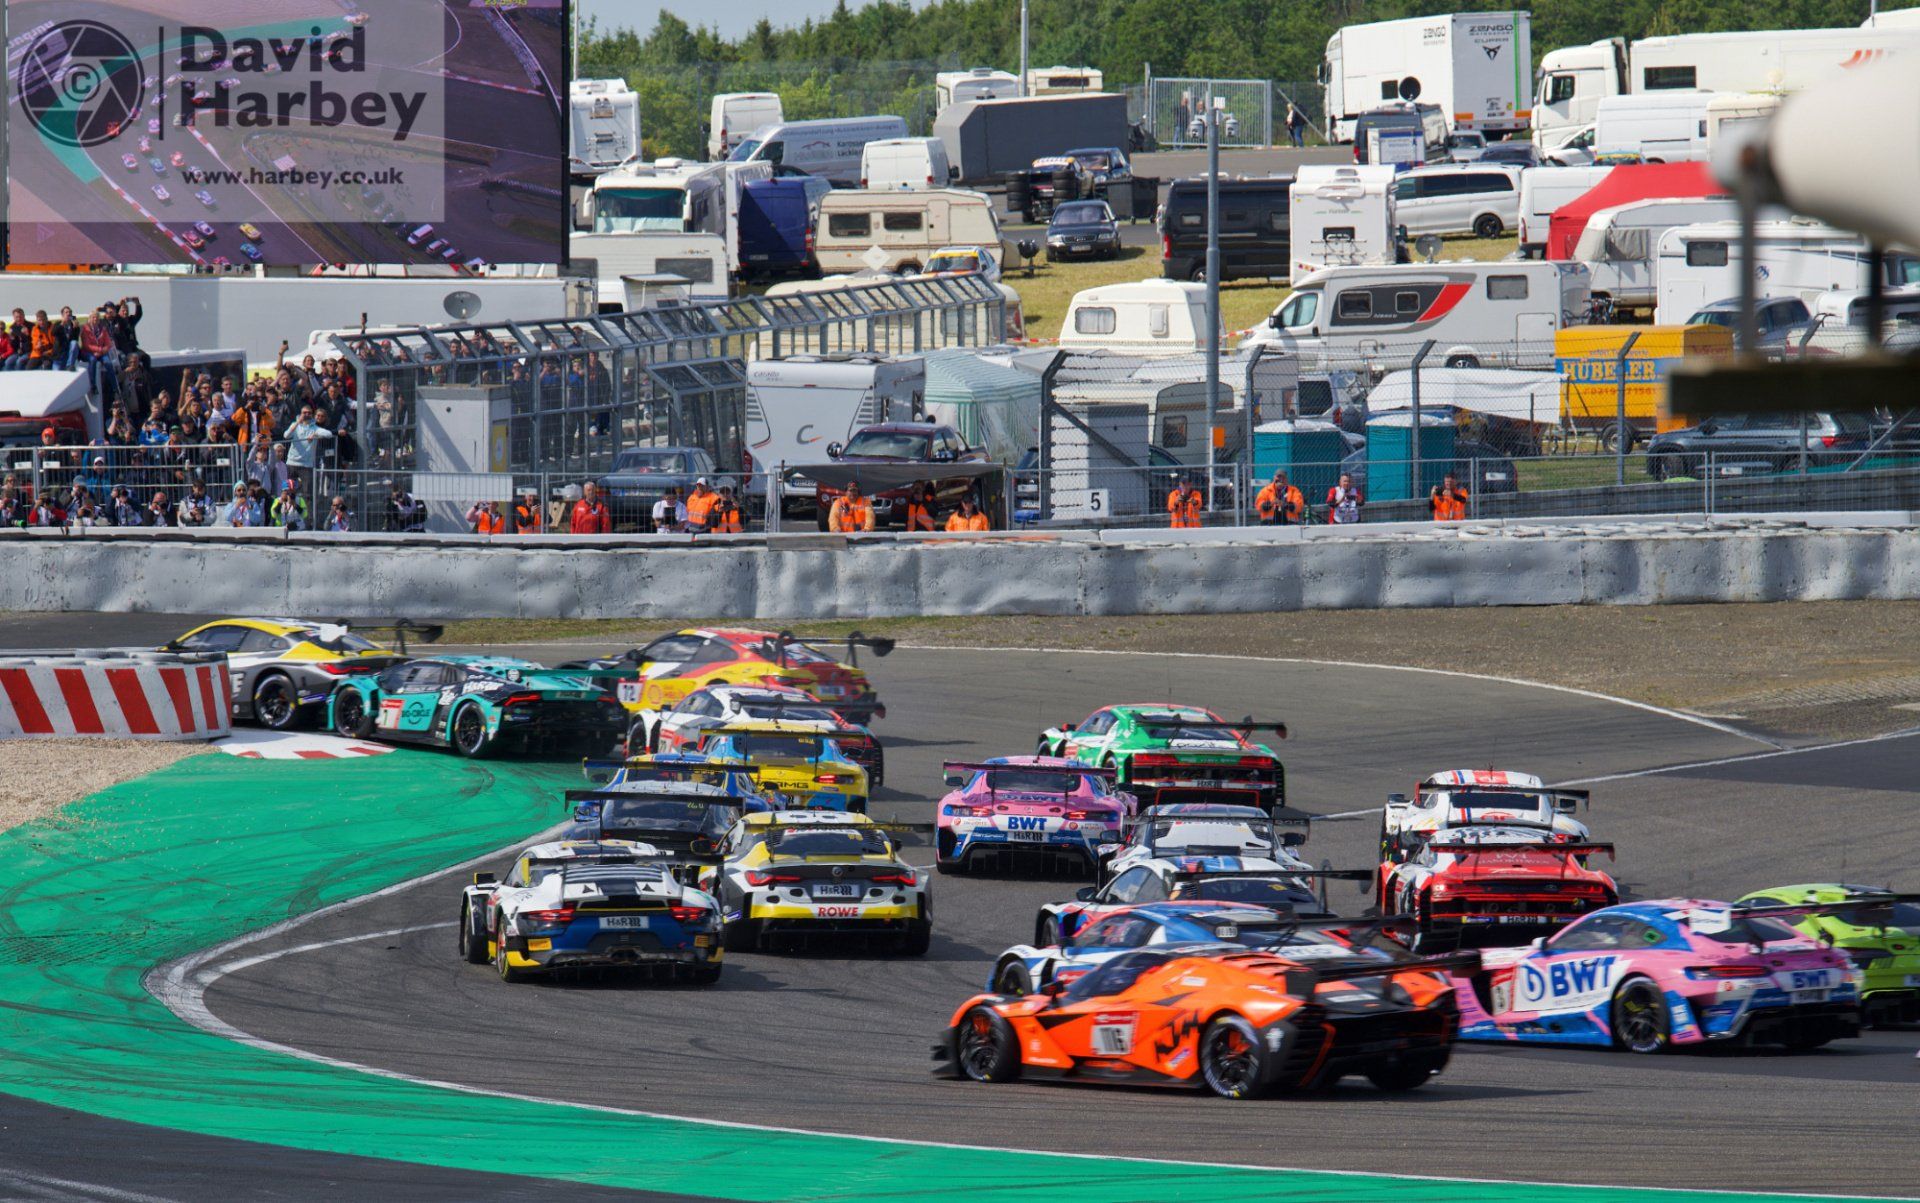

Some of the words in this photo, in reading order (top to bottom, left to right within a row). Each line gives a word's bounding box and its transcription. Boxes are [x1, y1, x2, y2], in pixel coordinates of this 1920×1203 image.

[1469, 24, 1513, 32] ZENGO
[1561, 358, 1656, 381] HÜBEER
[1090, 491, 1101, 511] 5
[1008, 816, 1048, 831] BWT
[817, 907, 859, 918] ROWE
[1550, 956, 1617, 998] BWT
